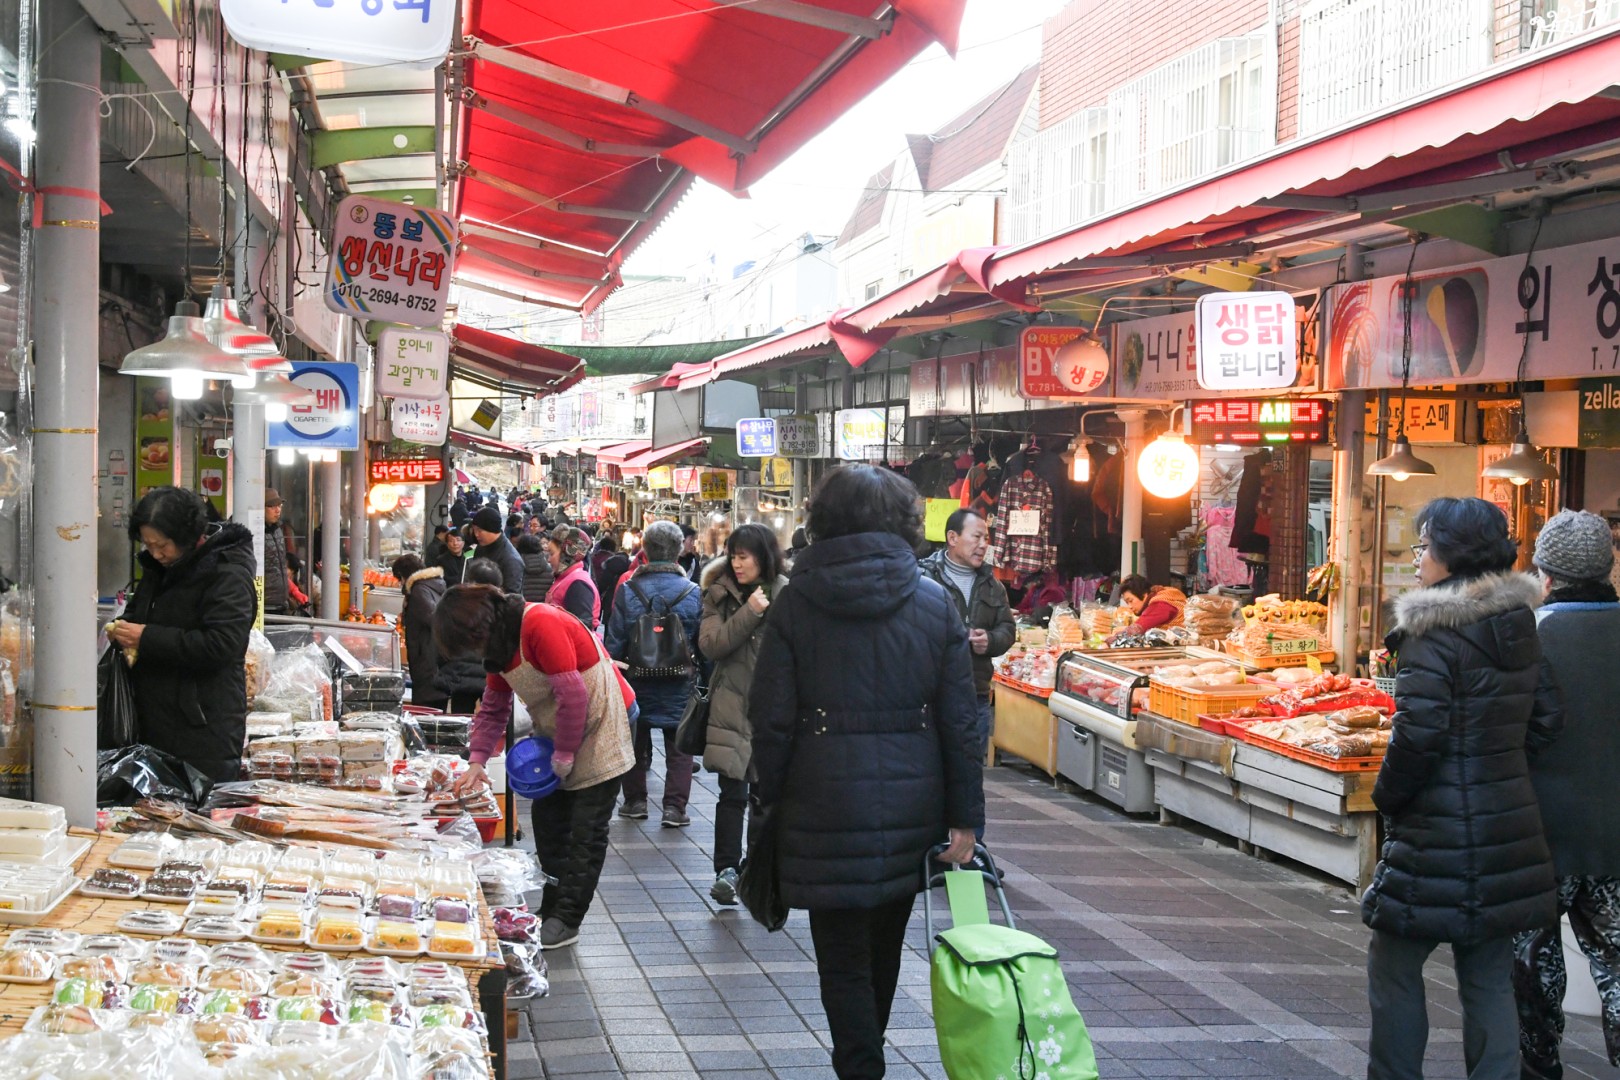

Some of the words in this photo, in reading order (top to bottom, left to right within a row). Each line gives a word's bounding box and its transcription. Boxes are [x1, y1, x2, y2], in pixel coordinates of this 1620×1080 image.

[373, 212, 424, 242] 뚱보
[341, 236, 446, 291] 생선나라
[338, 282, 437, 313] 010-2694-8752
[1216, 303, 1287, 346] 생닭
[387, 364, 439, 387] 과일가게
[1219, 351, 1286, 377] 팝니다
[399, 402, 442, 421] 이삭어묵
[1274, 642, 1293, 652] 국산
[1297, 640, 1317, 651] 황기
